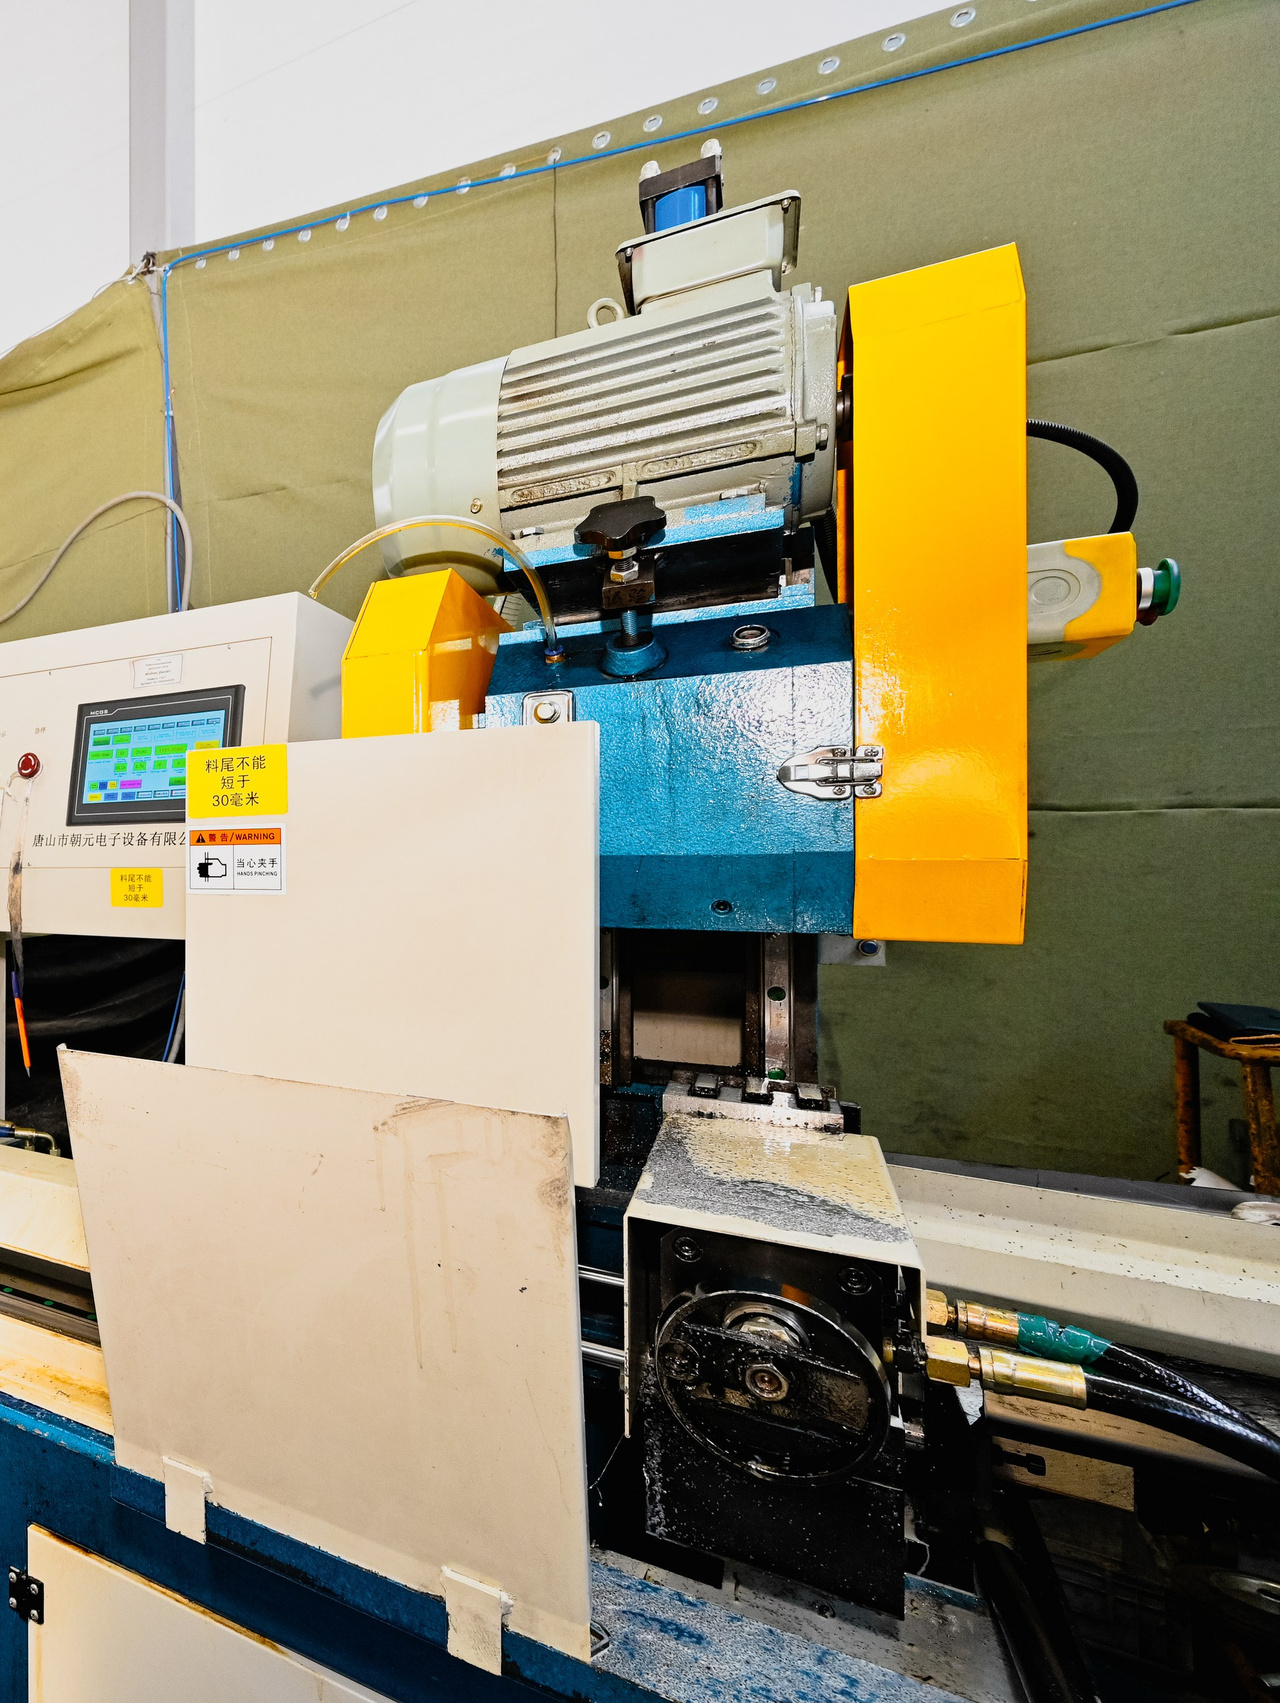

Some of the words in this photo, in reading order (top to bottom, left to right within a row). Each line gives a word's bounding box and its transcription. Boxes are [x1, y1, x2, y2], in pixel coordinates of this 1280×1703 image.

[205, 754, 266, 774] 料尾不能
[220, 774, 250, 790] 短于
[212, 791, 259, 807] 30毫米
[237, 858, 278, 869] 当心夹手
[120, 874, 152, 883] 料尾不能
[128, 884, 144, 893] 短于
[123, 894, 149, 903] 30毫米
